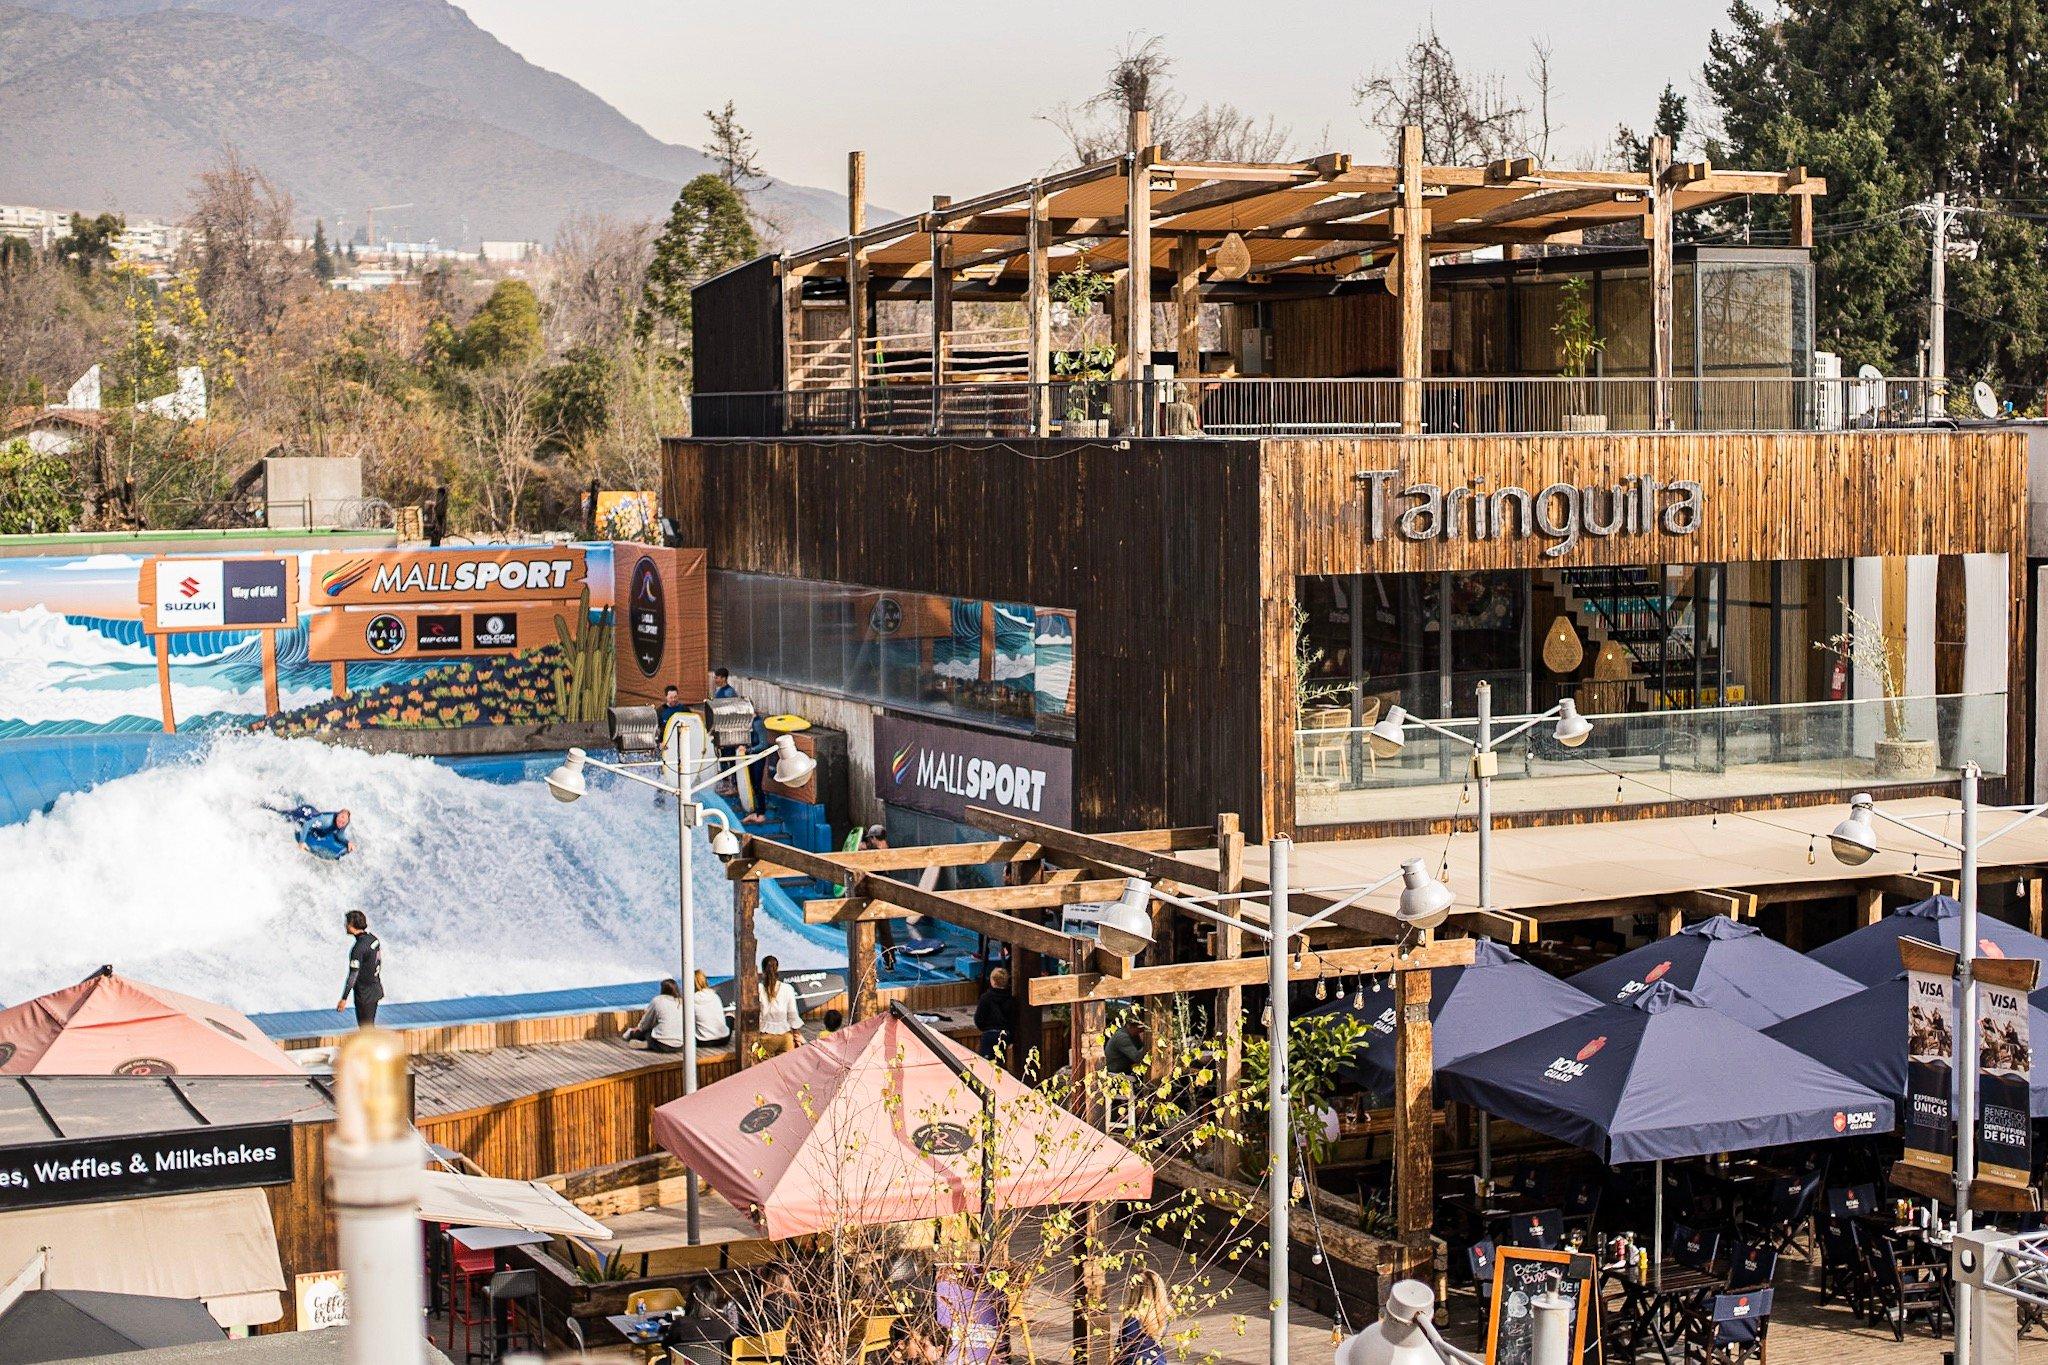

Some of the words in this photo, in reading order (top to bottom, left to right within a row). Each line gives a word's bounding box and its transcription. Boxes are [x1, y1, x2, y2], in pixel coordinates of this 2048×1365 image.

[1355, 469, 1703, 557] Taringuita
[372, 559, 573, 593] MALLSPORT
[232, 586, 249, 600] Way
[250, 586, 259, 598] of
[259, 585, 278, 598] Life!
[164, 601, 216, 611] SUZUKI
[368, 628, 403, 639] MAUI
[476, 634, 515, 642] VOLCOM
[916, 748, 1046, 812] MALLSPORT
[1917, 980, 1944, 998] VISA
[1988, 991, 2018, 1010] VISA
[1544, 1068, 1573, 1082] GUARD
[1548, 1057, 1589, 1077] ROYAL
[1914, 1100, 1948, 1117] ÚNICAS
[1847, 1111, 1876, 1124] ROYAL
[1984, 1130, 1998, 1141] DE
[1999, 1132, 2026, 1146] PISTA
[0, 1167, 29, 1188] es,
[34, 1157, 123, 1183] Waffles
[129, 1152, 149, 1174] &
[155, 1143, 277, 1172] Milkshakes
